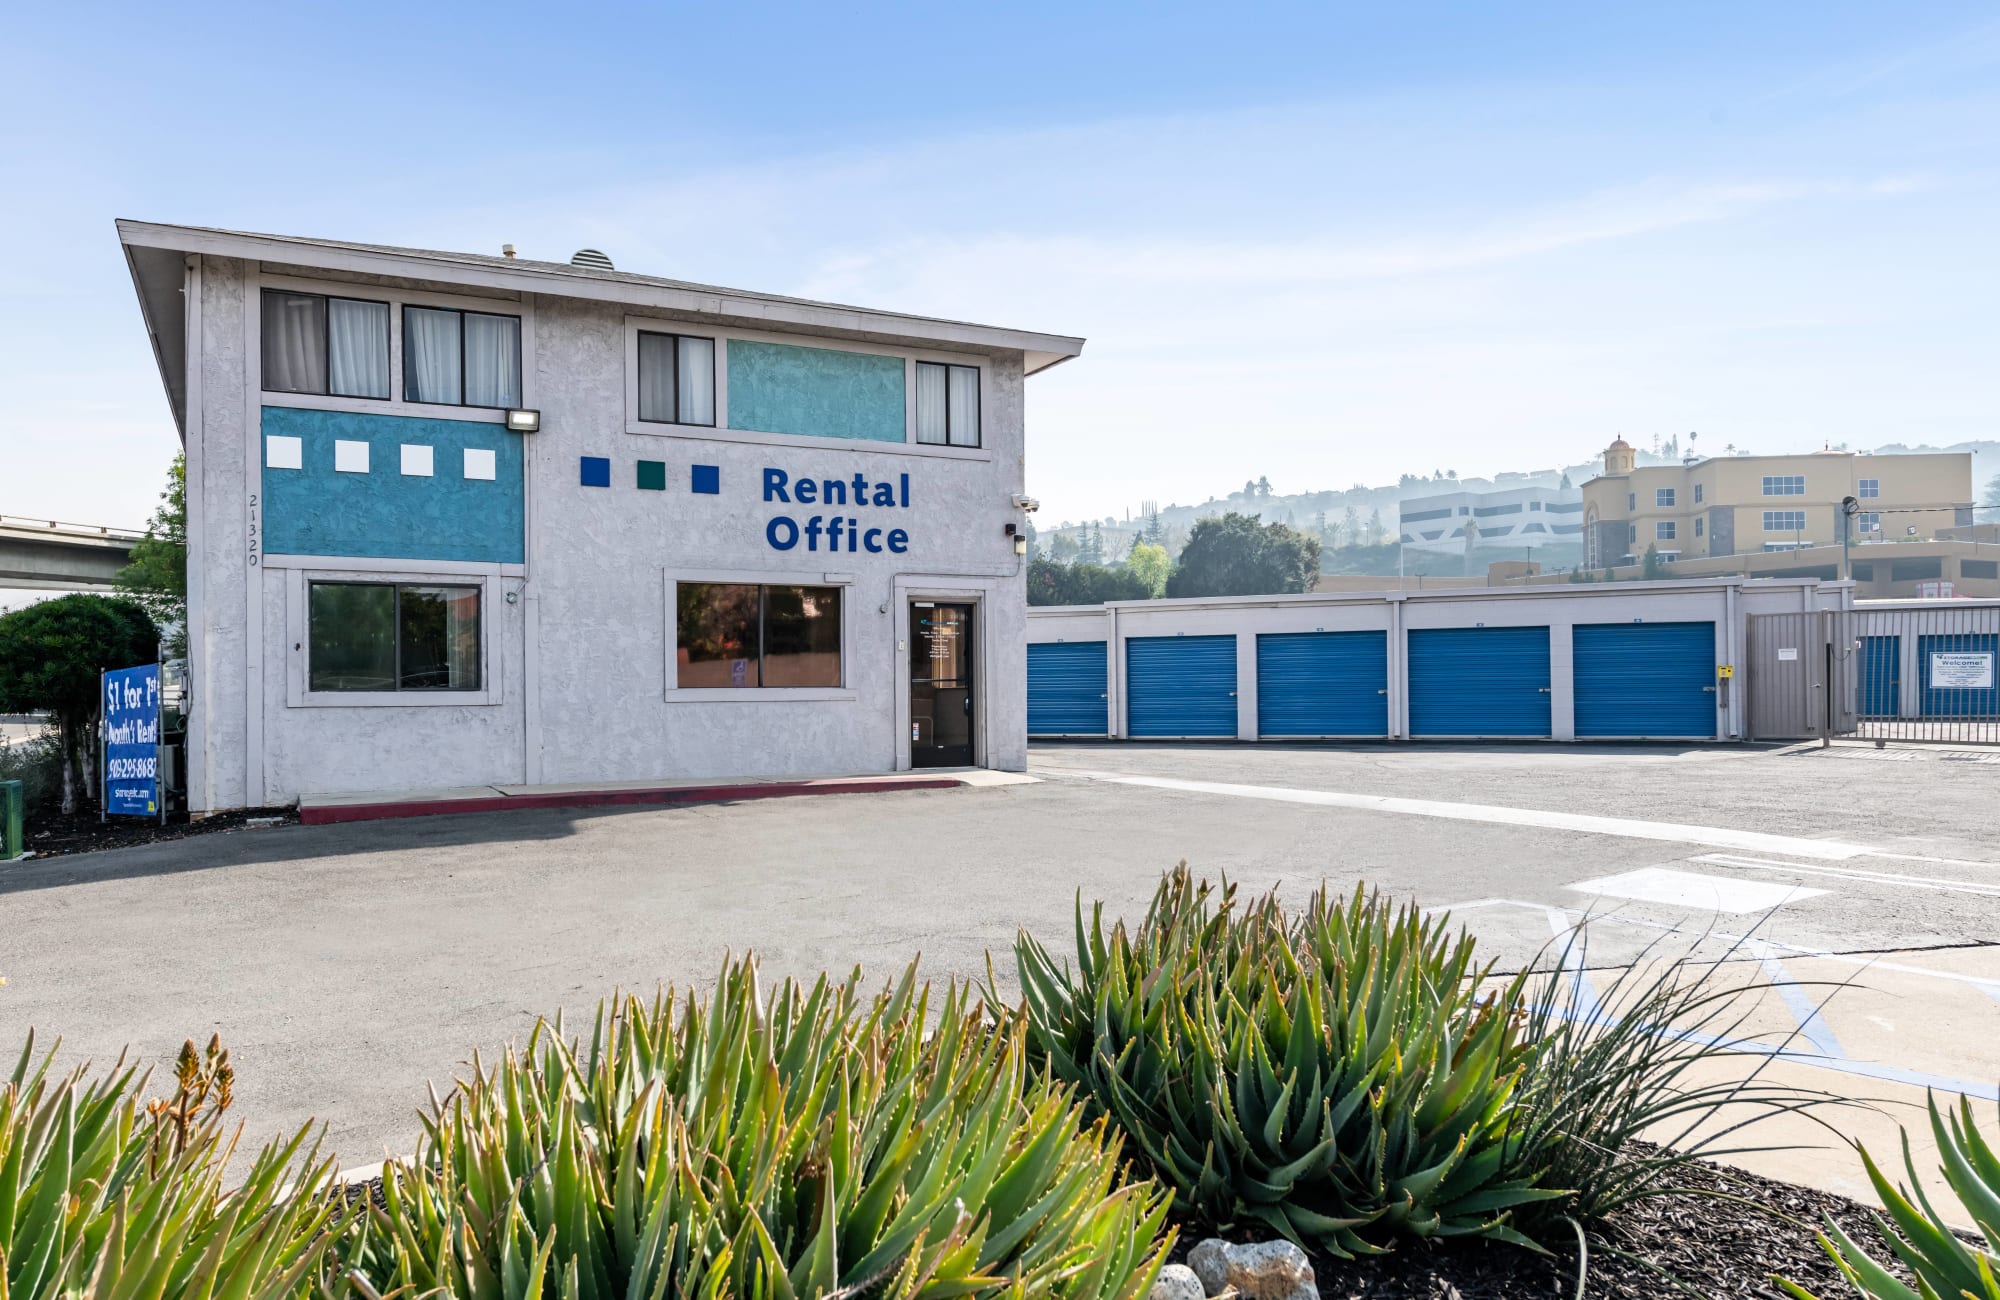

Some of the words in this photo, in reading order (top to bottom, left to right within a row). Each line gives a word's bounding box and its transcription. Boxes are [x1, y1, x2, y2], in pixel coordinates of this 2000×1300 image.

[763, 468, 910, 508] Rental
[249, 494, 258, 566] 21320
[766, 515, 909, 554] Office
[108, 678, 120, 715] $1
[124, 677, 142, 710] for
[146, 676, 157, 707] 1st
